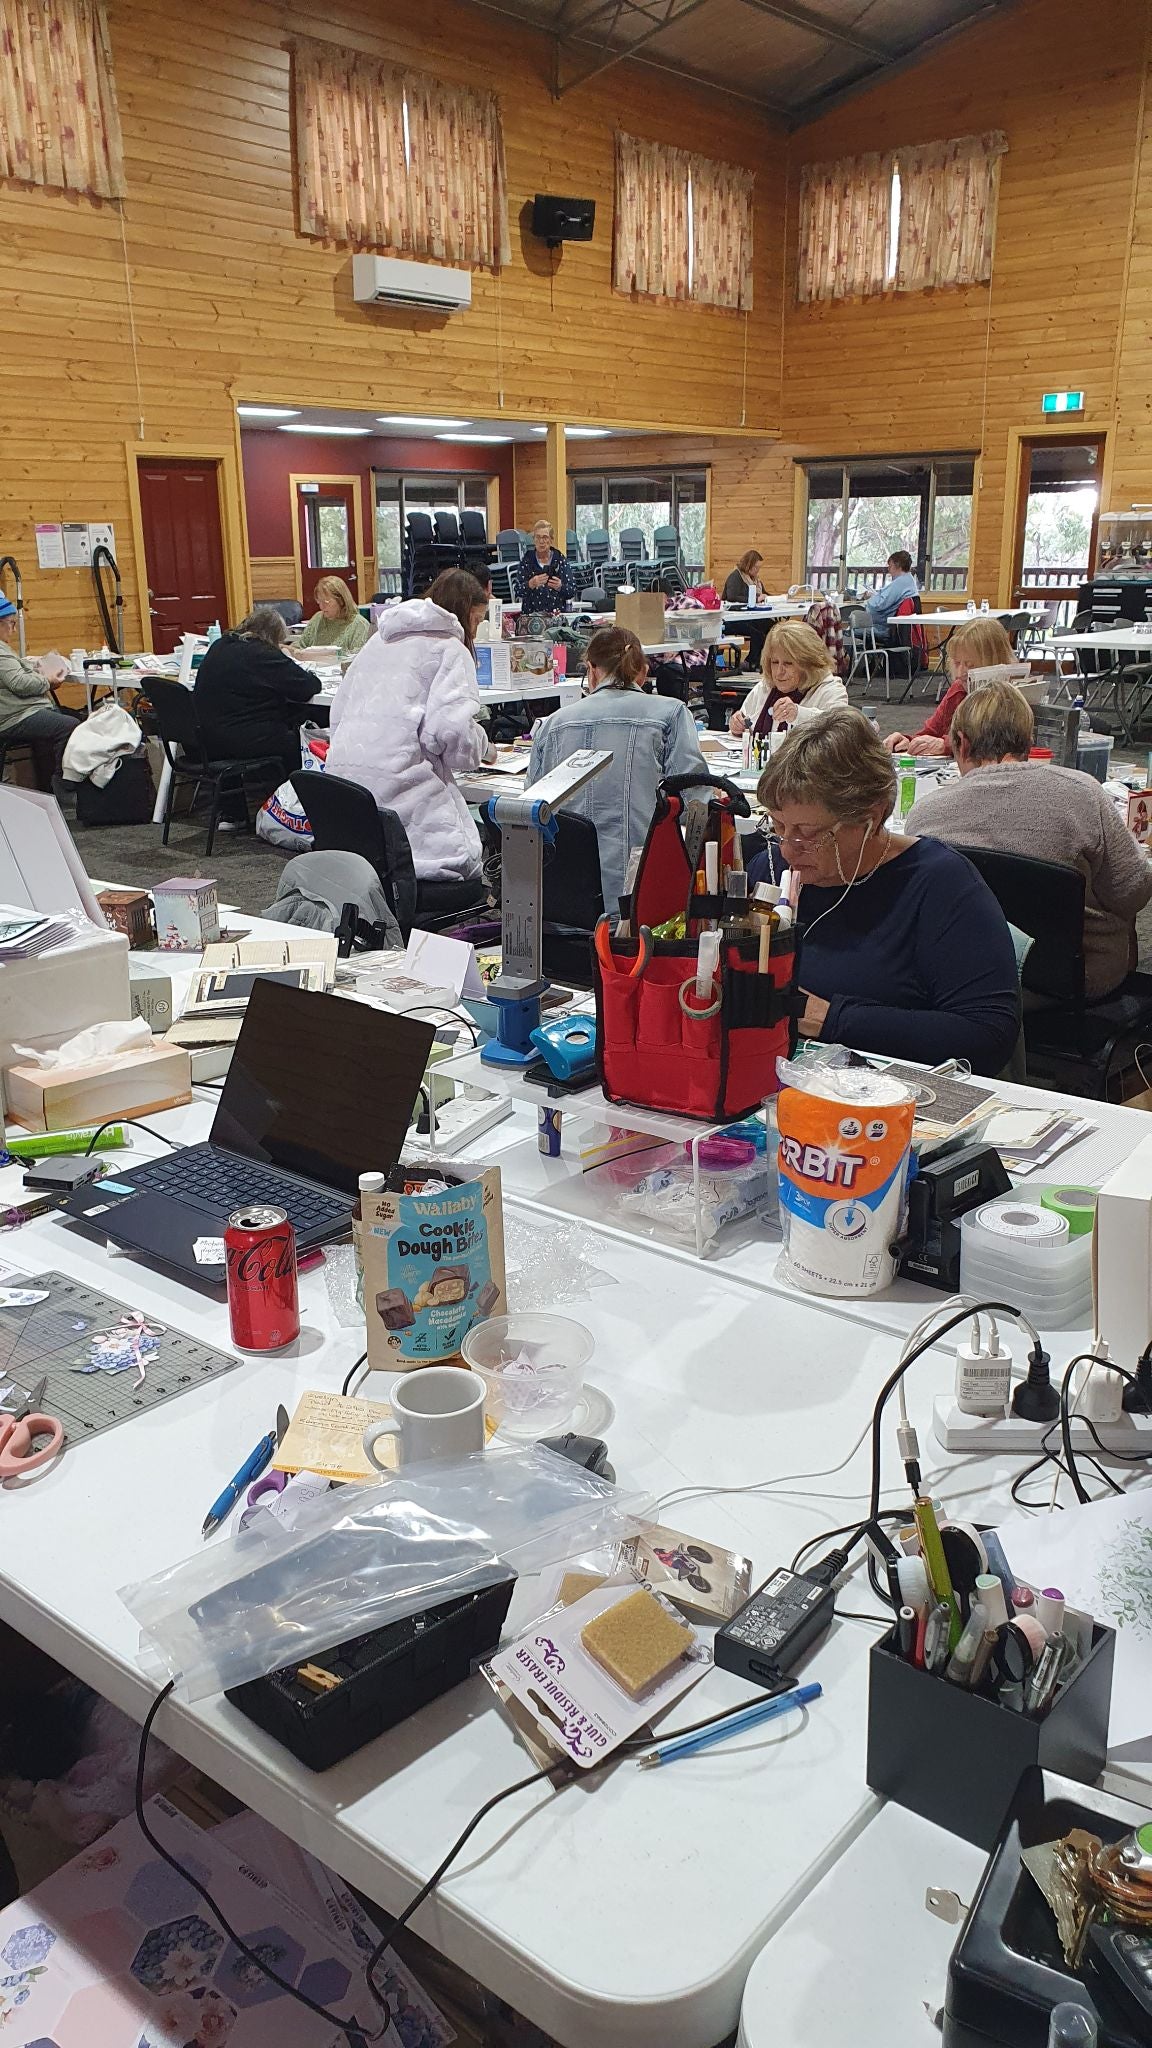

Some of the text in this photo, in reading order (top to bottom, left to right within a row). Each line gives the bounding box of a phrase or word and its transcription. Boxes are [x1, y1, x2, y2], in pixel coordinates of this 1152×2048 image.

[376, 1205, 396, 1214] Added
[413, 1195, 477, 1216] Wallaby
[375, 1211, 394, 1220] Sugar
[374, 1227, 391, 1236] NEW
[419, 1218, 475, 1237] Cookie
[398, 1238, 453, 1261] Dough
[456, 1230, 484, 1253] Bites
[801, 1265, 823, 1280] SHEETS
[428, 1311, 467, 1325] Macadamia
[430, 1306, 465, 1317] Chocolate
[516, 1648, 548, 1683] ERASER
[543, 1680, 580, 1718] RESIDUE
[583, 1724, 608, 1748] GLUE
